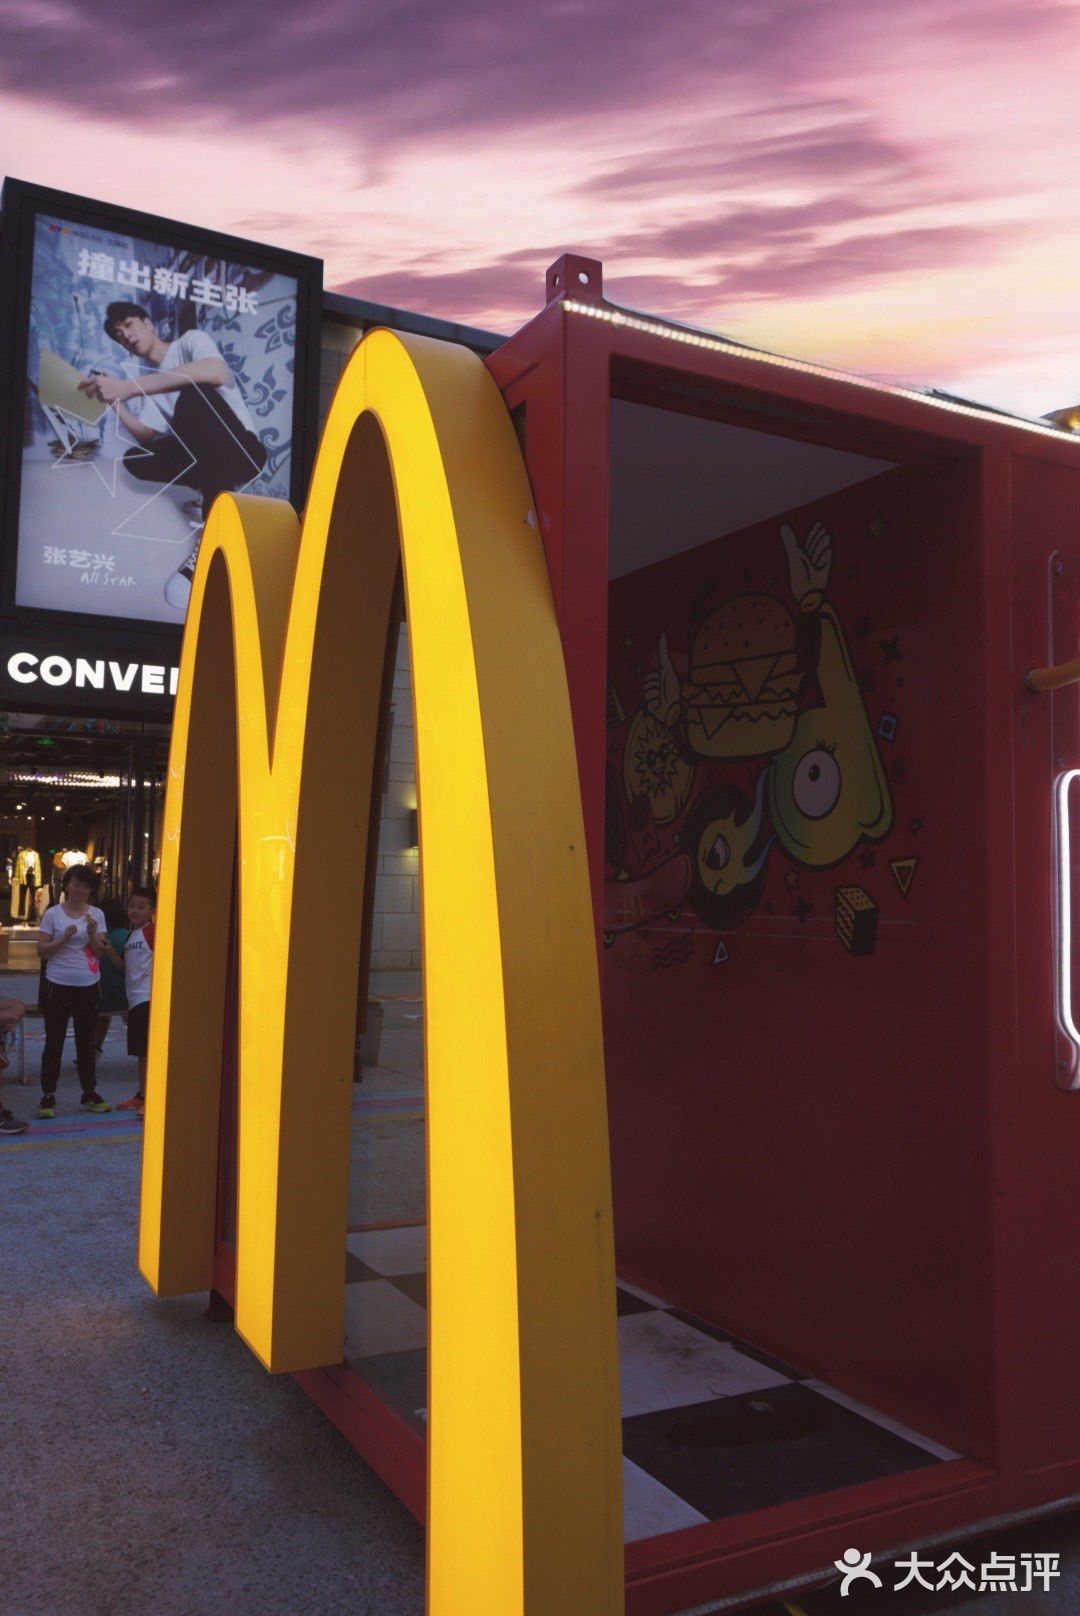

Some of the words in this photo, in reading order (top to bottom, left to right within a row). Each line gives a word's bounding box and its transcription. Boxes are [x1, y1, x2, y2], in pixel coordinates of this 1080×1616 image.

[77, 248, 258, 315] 撞出新主张
[43, 545, 116, 572] 张艺兴
